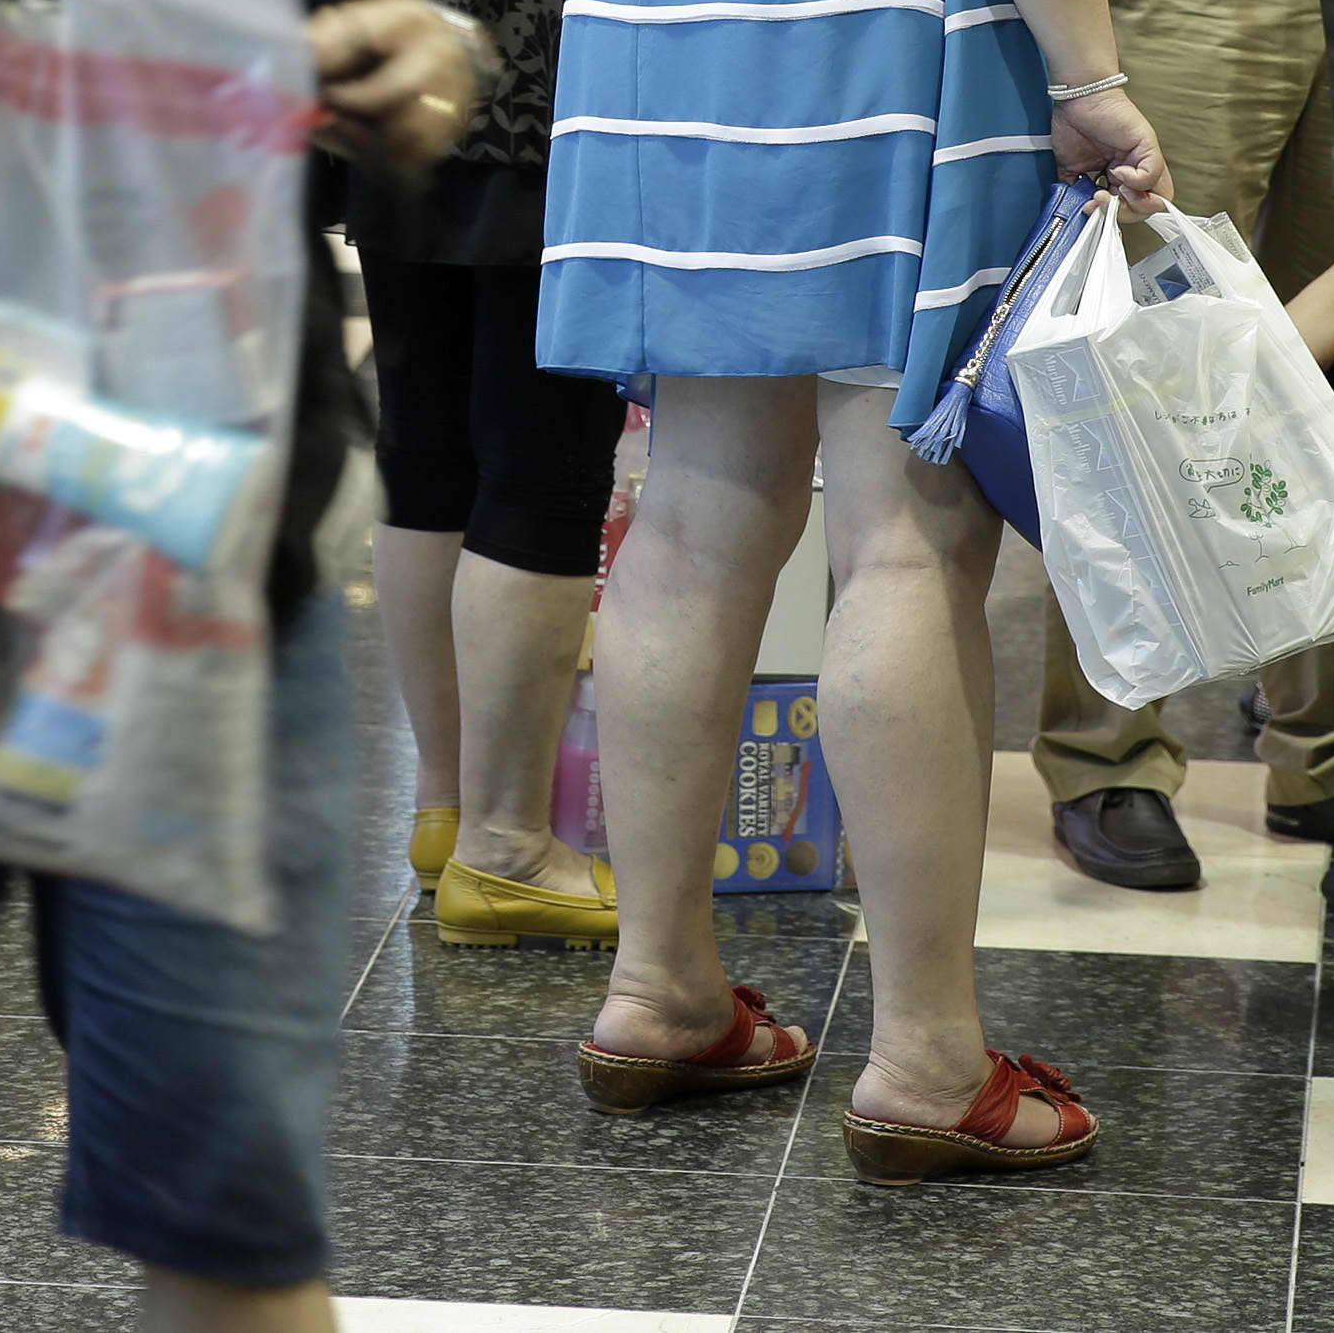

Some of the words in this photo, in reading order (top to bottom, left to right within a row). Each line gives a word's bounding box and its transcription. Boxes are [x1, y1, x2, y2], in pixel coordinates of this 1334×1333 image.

[1044, 354, 1067, 405] Marlboro
[1247, 576, 1284, 596] FamilyMart
[758, 742, 771, 783] ROYAL
[739, 740, 758, 838] COOKIES
[758, 785, 771, 837] VARIETY
